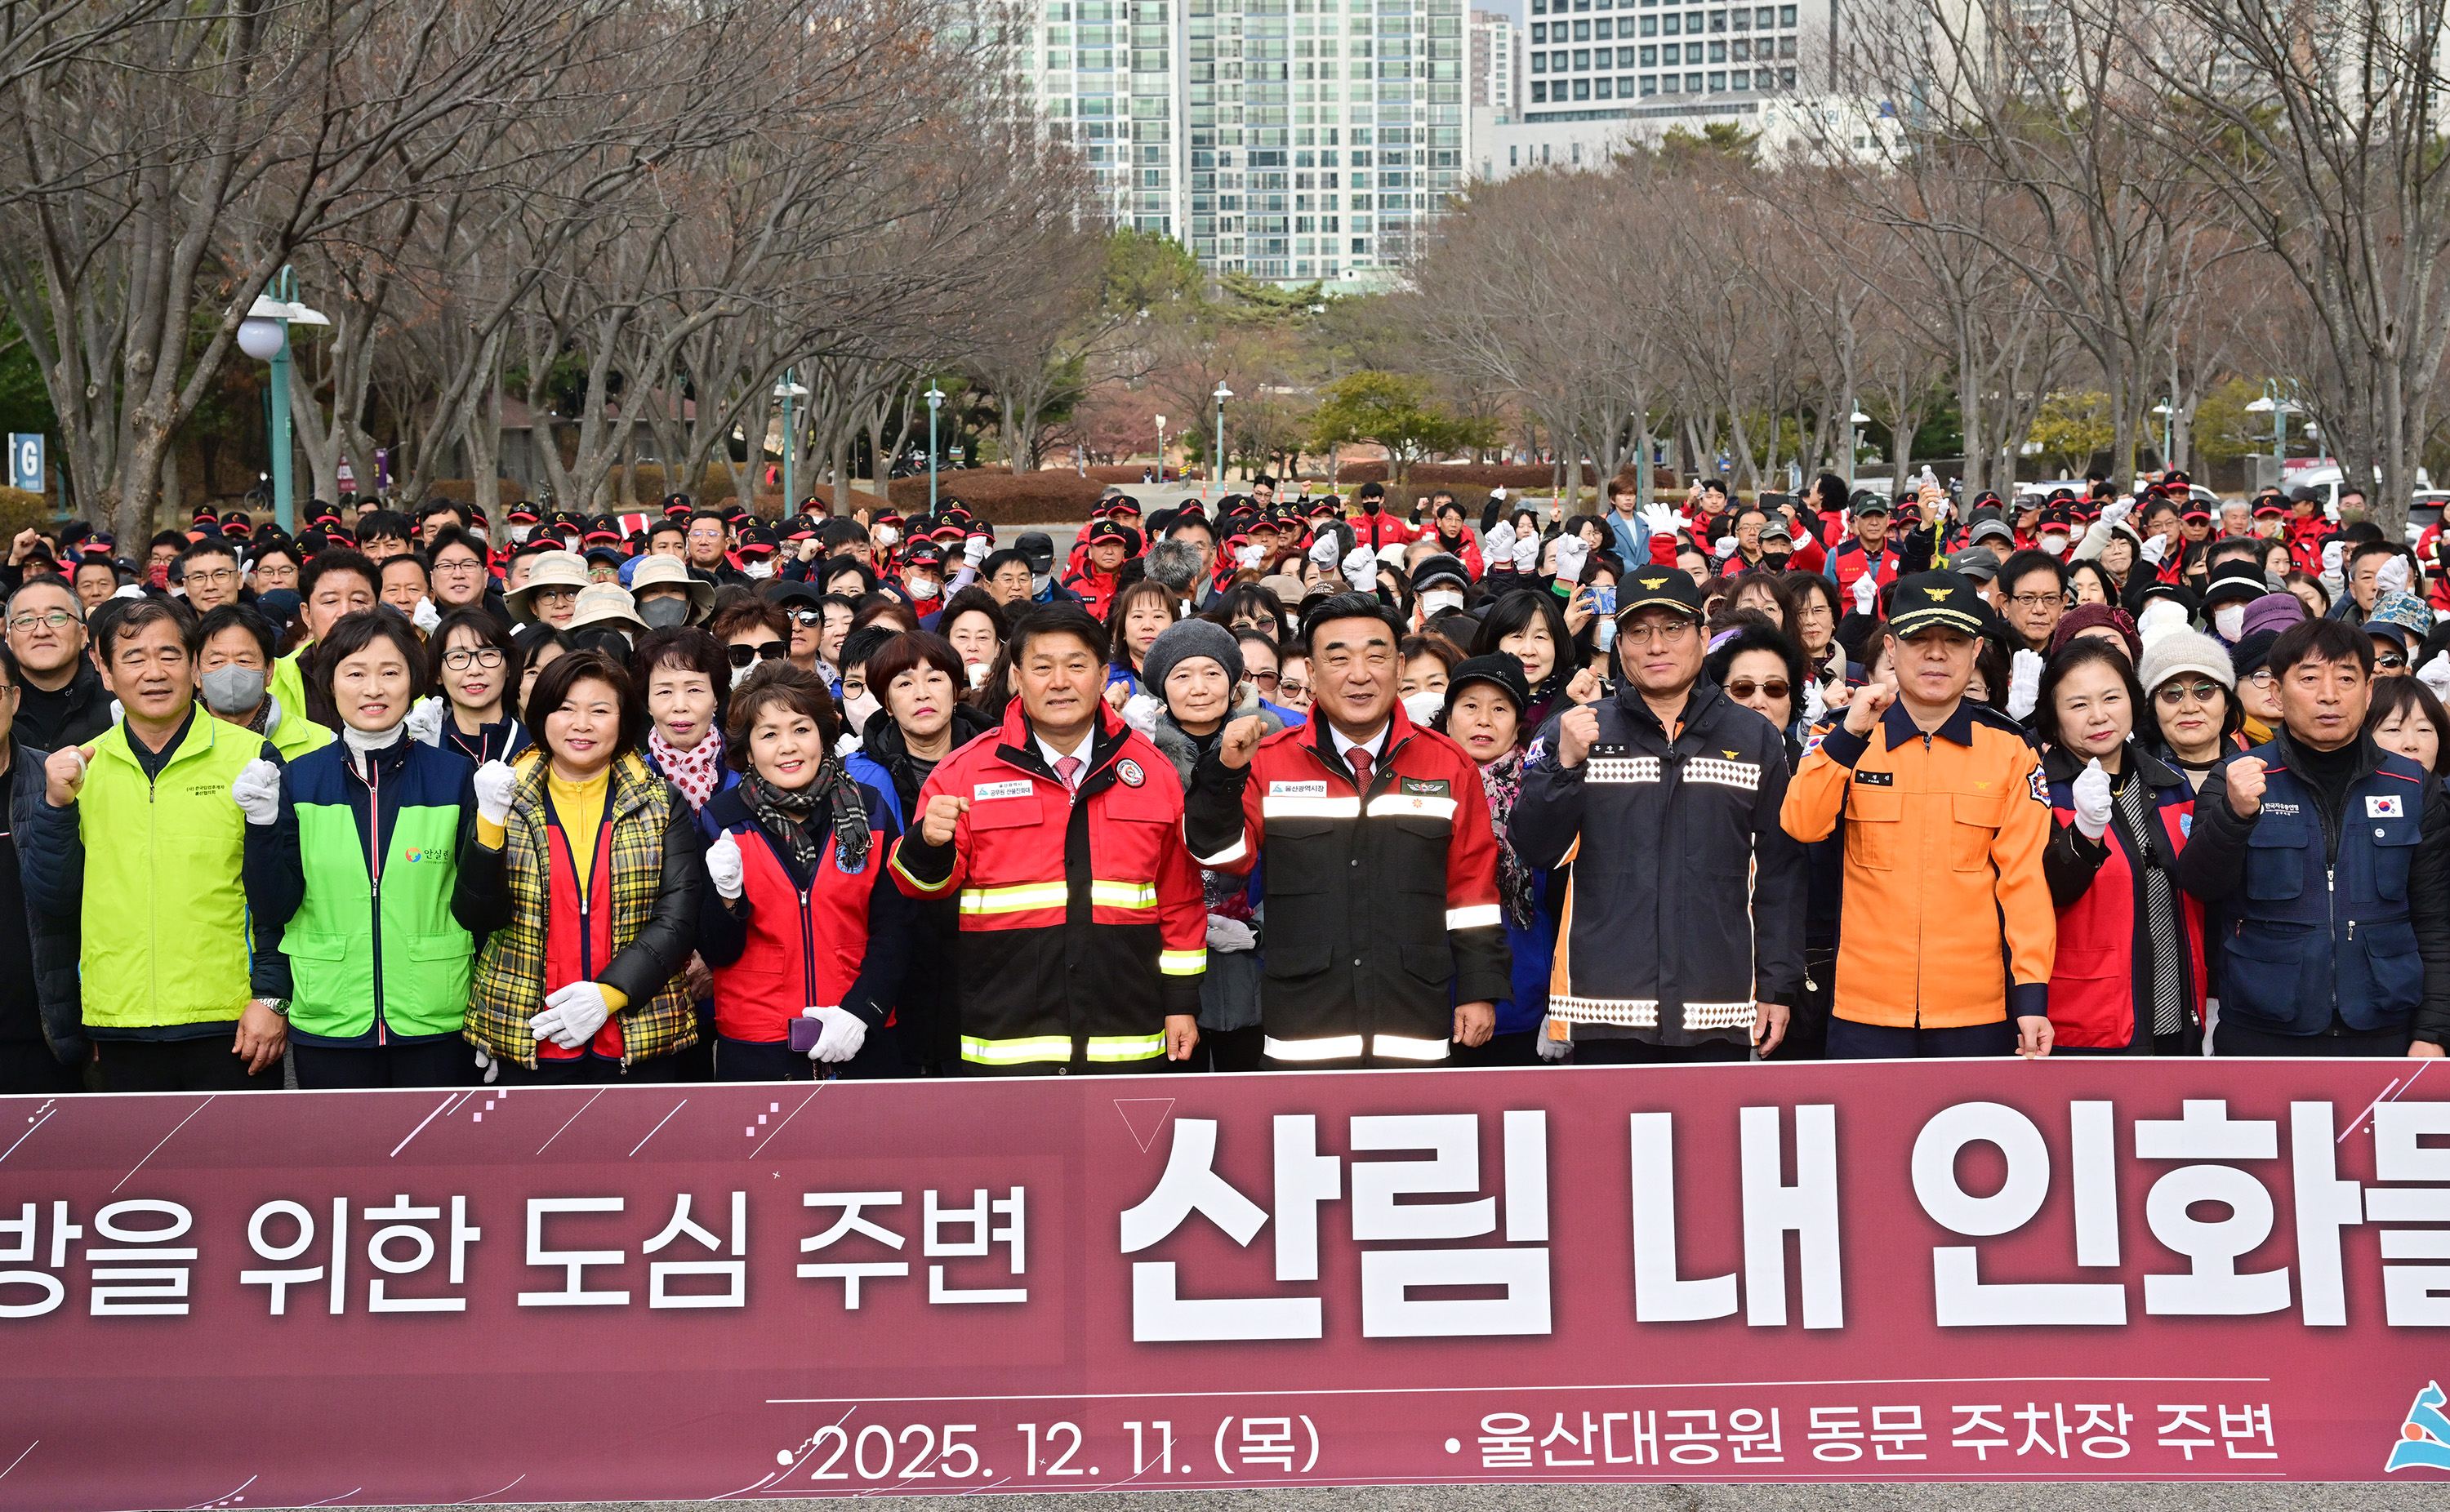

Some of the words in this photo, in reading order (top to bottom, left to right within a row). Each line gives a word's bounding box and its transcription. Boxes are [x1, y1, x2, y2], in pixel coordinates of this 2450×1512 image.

[21, 440, 38, 477] G
[990, 789, 1005, 797] 공무원
[1006, 787, 1031, 795] 산불진화대
[1285, 785, 1325, 793] 울산광역시장
[2265, 803, 2300, 811] 한국자유총연맹
[241, 1194, 480, 1314] 위한
[518, 1192, 745, 1308] 도심
[797, 1187, 1027, 1309] 주변
[1121, 1110, 1552, 1341] 산림
[1631, 1105, 1843, 1328] 내
[811, 1424, 993, 1479] 2025.
[1018, 1422, 1099, 1475] 12.
[1124, 1421, 1192, 1474] 11.
[1215, 1416, 1319, 1473] (목)
[1478, 1408, 1784, 1467] 울산대공원
[1808, 1406, 1927, 1462] 동문
[1952, 1403, 2133, 1461] 주차장
[2157, 1403, 2278, 1461] 주변
